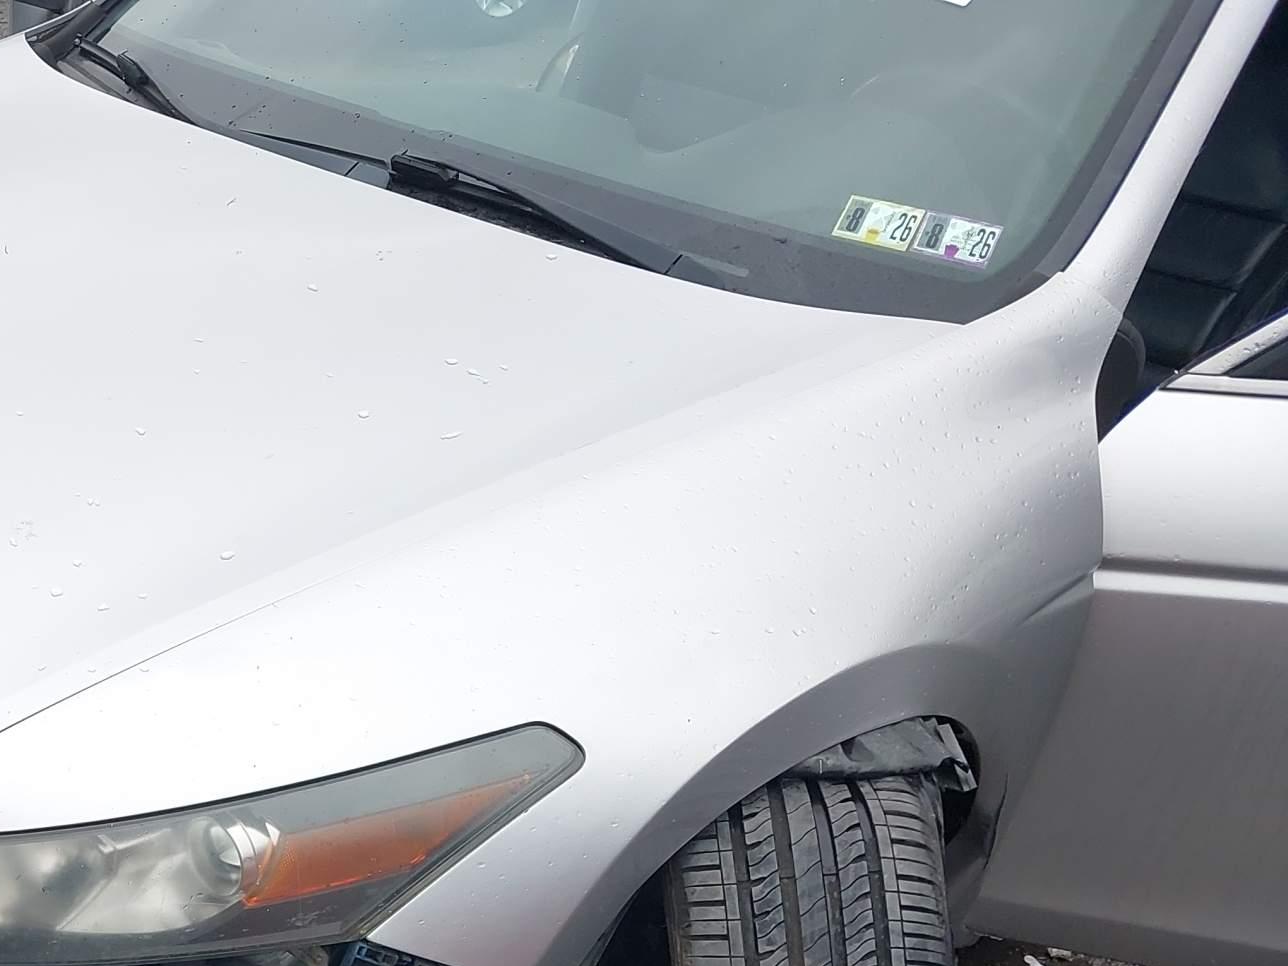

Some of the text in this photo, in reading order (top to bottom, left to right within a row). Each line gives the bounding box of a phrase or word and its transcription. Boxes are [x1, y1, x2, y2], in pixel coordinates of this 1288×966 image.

[845, 207, 866, 232] 8
[889, 212, 918, 242] 26
[925, 223, 945, 249] 8
[968, 228, 997, 260] 26
